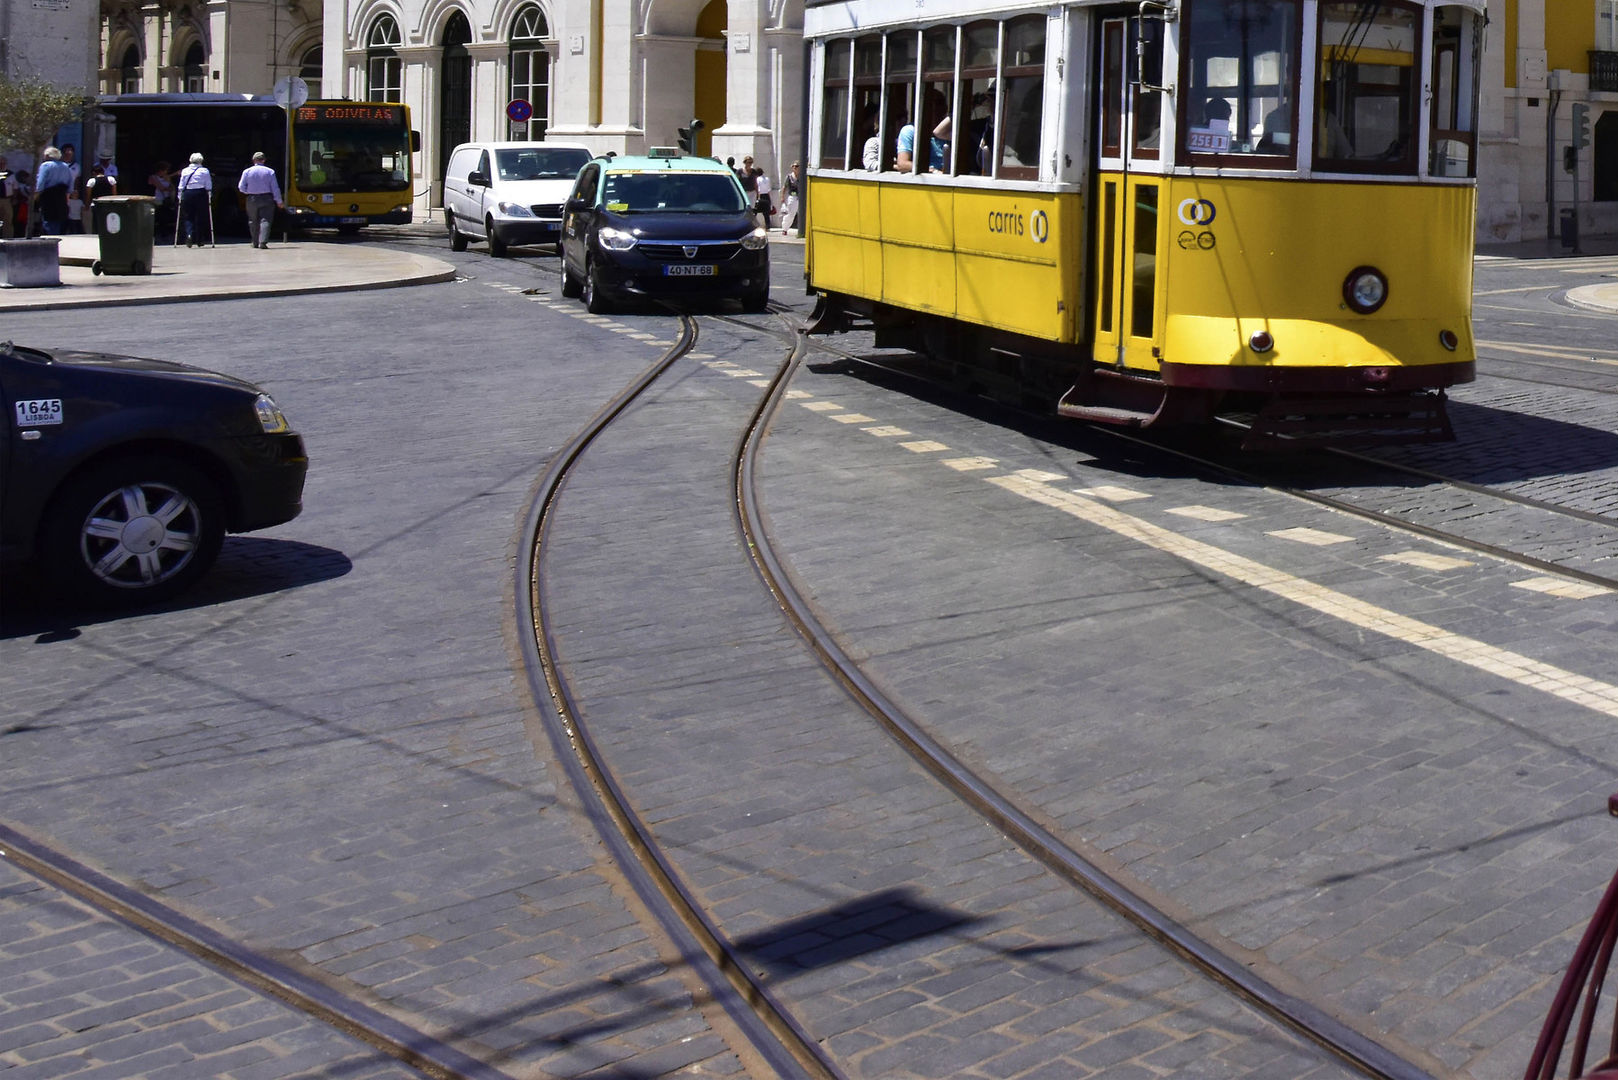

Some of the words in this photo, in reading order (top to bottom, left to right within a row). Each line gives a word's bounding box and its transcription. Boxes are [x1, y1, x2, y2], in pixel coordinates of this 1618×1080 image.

[1191, 134, 1211, 147] 25E
[988, 204, 1024, 236] carris
[18, 401, 60, 415] 1645
[26, 414, 54, 422] LISBOA
